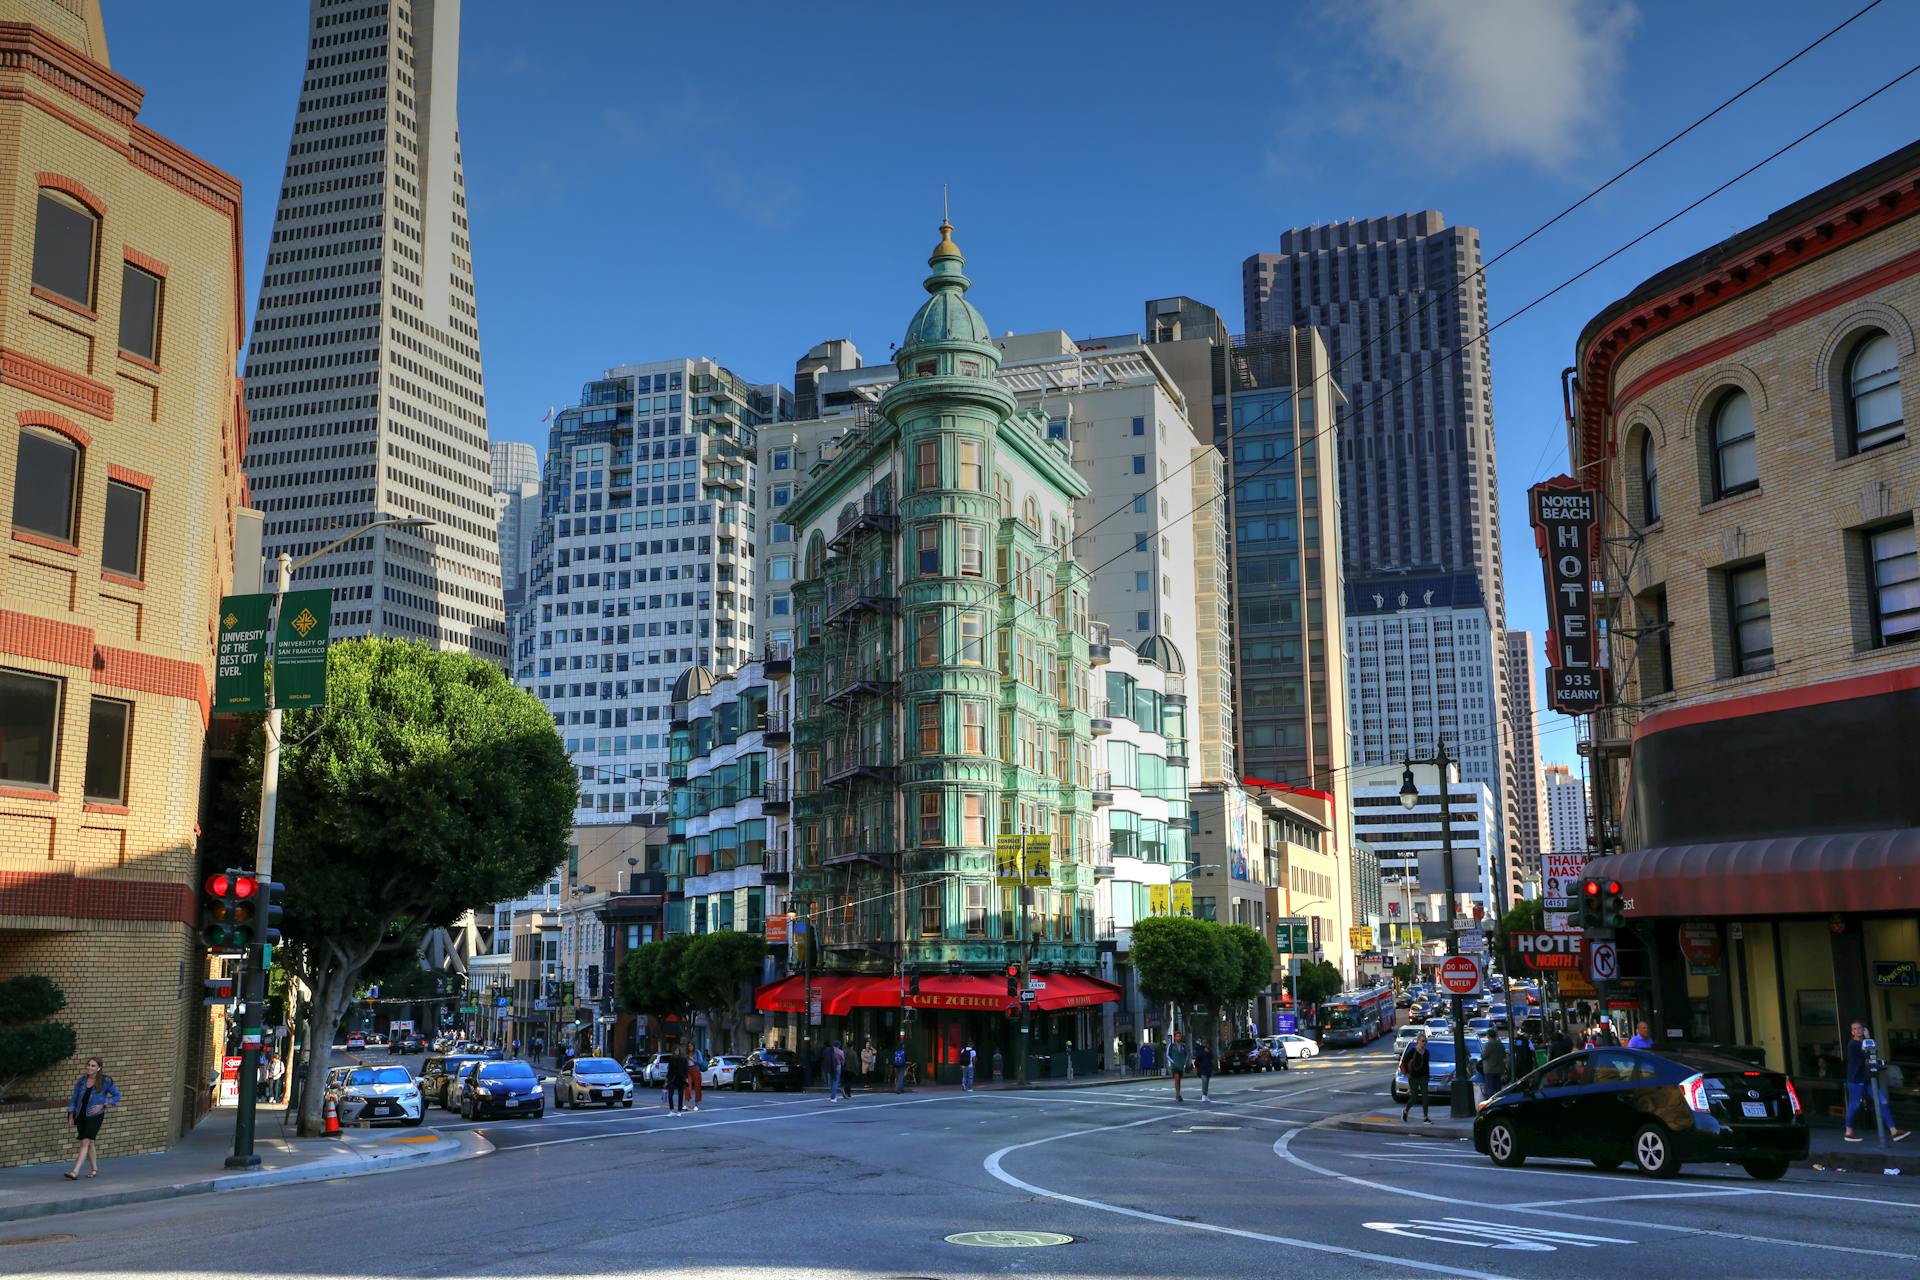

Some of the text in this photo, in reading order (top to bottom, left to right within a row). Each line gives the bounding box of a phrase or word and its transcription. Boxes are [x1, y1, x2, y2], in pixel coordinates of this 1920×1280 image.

[1541, 495, 1590, 508] NORTH
[1542, 507, 1591, 520] BEACH
[1558, 525, 1589, 668] HOTEL
[221, 630, 264, 643] UNIVERSITY
[220, 642, 249, 654] OF THE
[278, 640, 316, 648] UNIVERSITY
[292, 647, 325, 655] FRANCISCO
[219, 653, 258, 666] BEST CITY
[219, 666, 242, 677] EVER.
[1564, 674, 1592, 686] 935
[1557, 688, 1600, 700] KEARNY
[1547, 855, 1588, 867] THAILA
[1549, 866, 1582, 877] MASS
[1545, 899, 1565, 908] (415)
[1518, 934, 1582, 953] HOTE
[1536, 953, 1571, 967] NORTH
[912, 994, 941, 1005] CAFE
